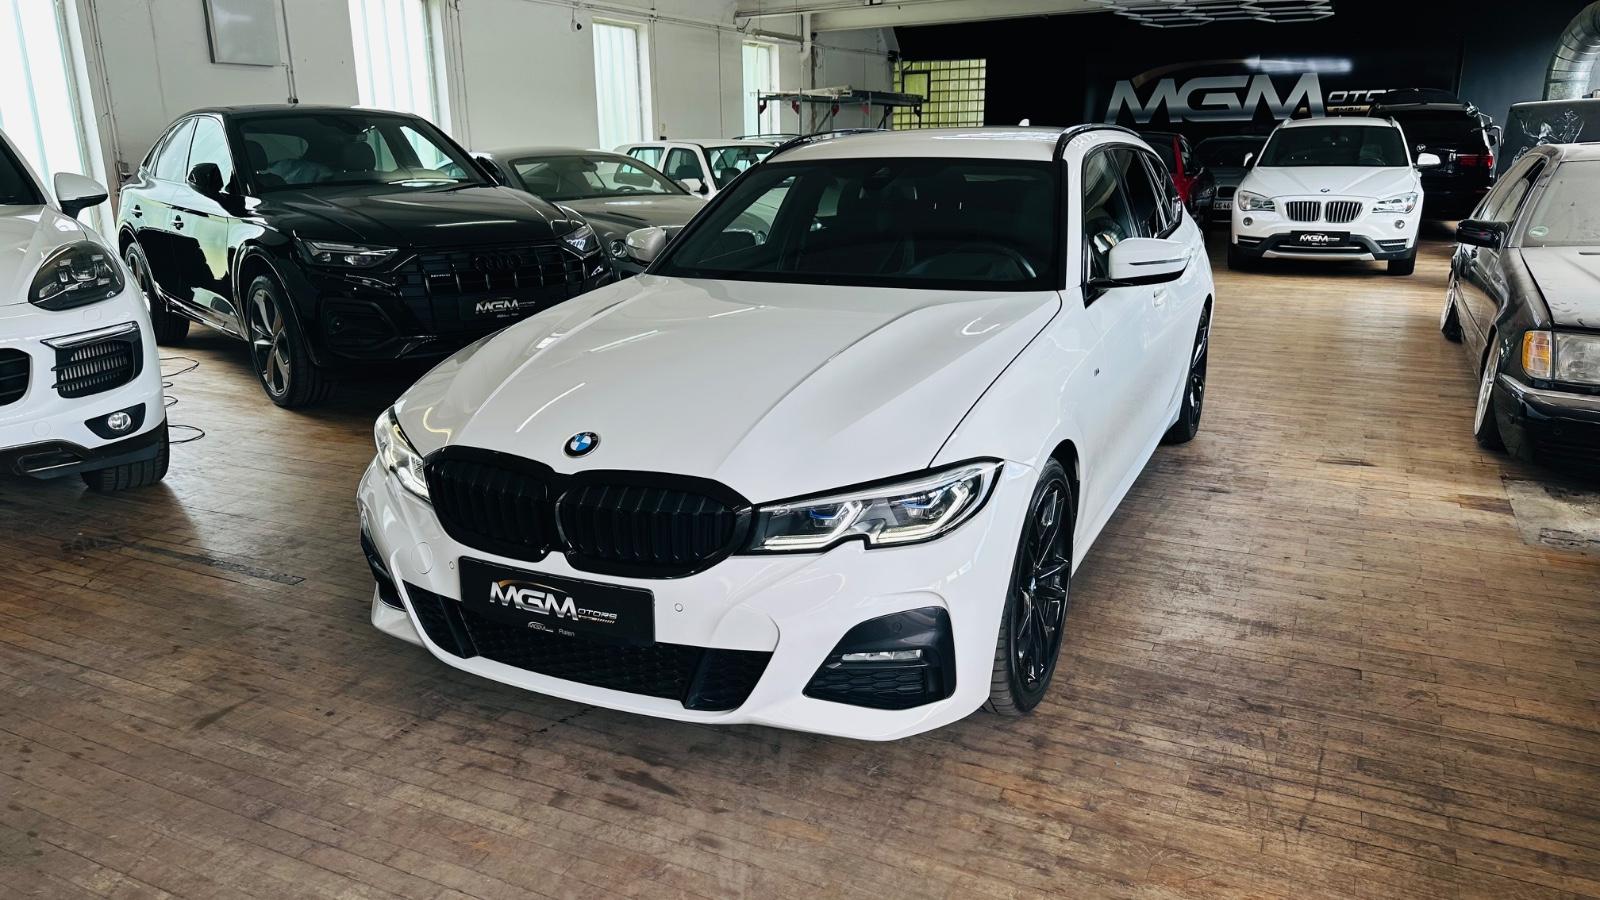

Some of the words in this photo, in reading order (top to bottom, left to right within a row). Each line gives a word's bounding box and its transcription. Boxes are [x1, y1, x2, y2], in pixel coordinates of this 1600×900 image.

[1104, 72, 1326, 124] MGM
[1299, 234, 1329, 243] MGM
[475, 299, 520, 314] MGM
[489, 581, 579, 621] MGM
